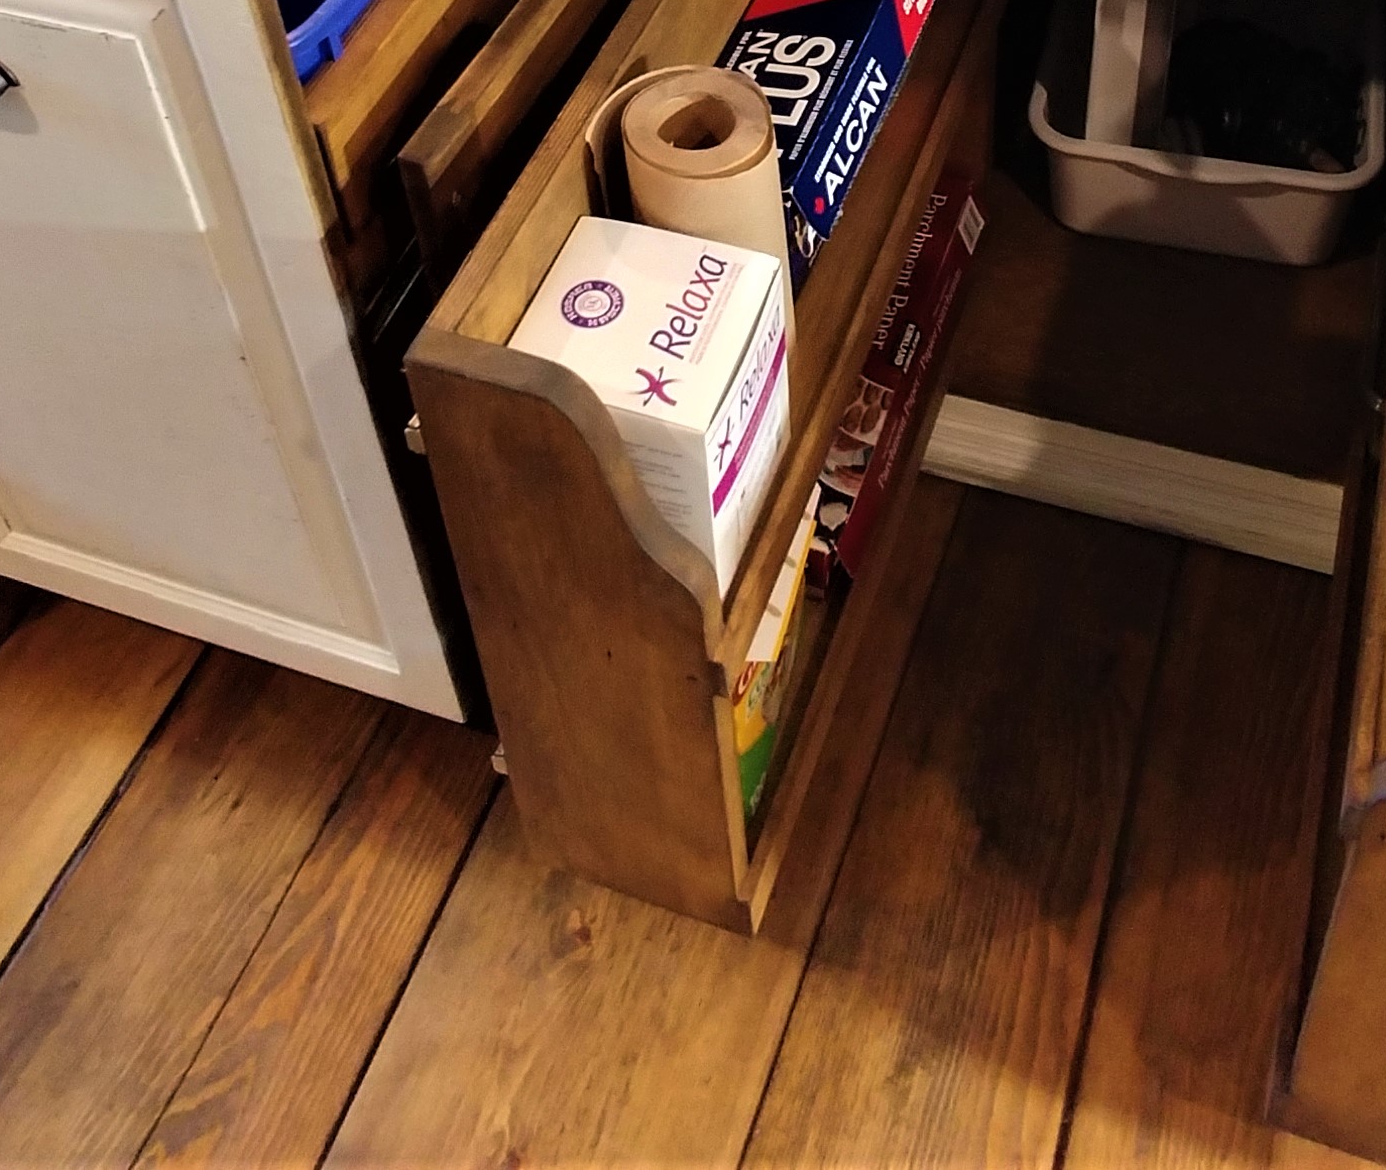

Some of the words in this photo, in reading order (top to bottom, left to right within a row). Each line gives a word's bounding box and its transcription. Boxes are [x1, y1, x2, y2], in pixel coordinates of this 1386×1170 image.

[823, 67, 888, 206] ALCAN
[898, 193, 948, 288] Parchment
[649, 253, 728, 360] Relaxa
